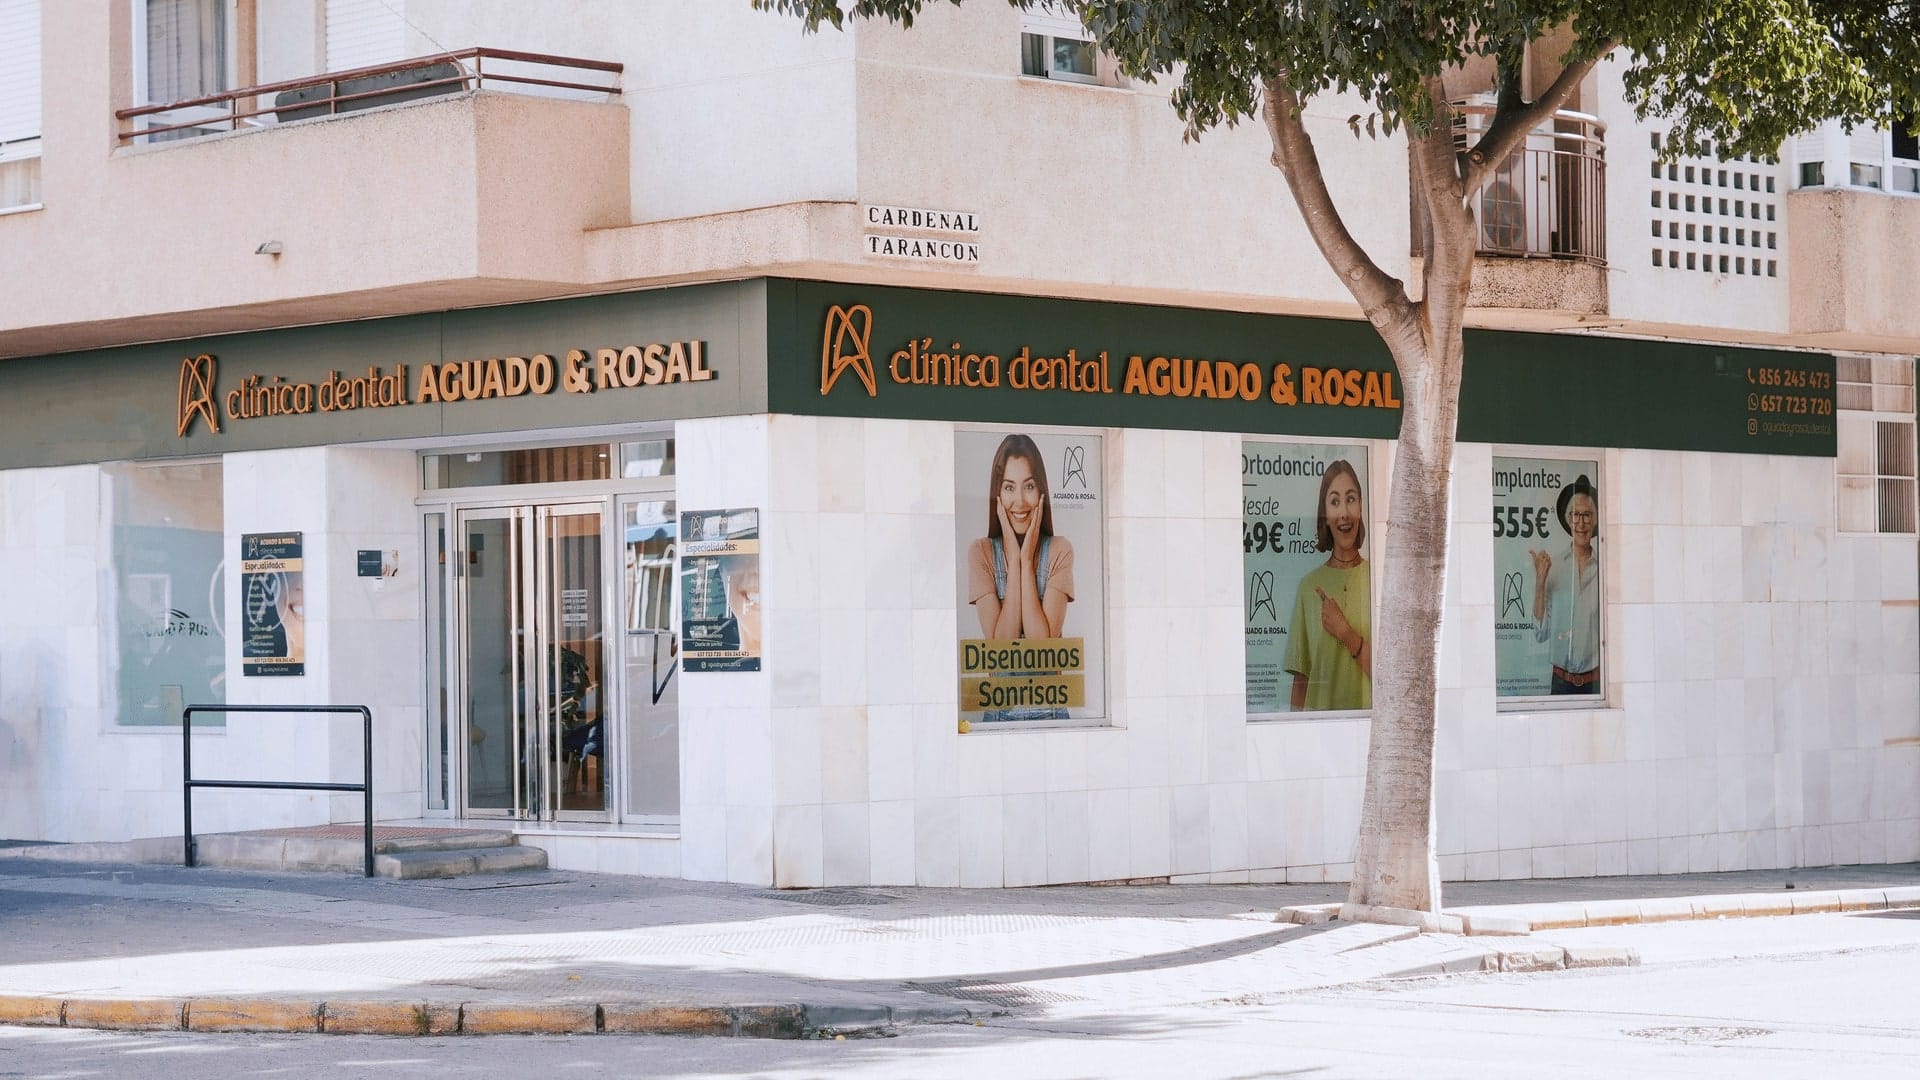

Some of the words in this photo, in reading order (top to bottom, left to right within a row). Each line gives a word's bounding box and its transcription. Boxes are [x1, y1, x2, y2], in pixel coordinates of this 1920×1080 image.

[869, 207, 978, 231] CARDENAL
[869, 237, 978, 261] TARANCON
[226, 374, 312, 420] clínica
[318, 362, 408, 412] dental
[416, 354, 554, 404] AGUADO
[563, 349, 592, 394] &
[597, 339, 713, 389] ROSAL
[890, 337, 1000, 388] clínica
[1008, 346, 1113, 393] dental
[1123, 355, 1262, 401] AGUADO
[1270, 362, 1297, 406] &
[1302, 367, 1400, 409] ROSAL
[1759, 367, 1781, 386] 856
[1784, 369, 1806, 388] 245
[1809, 371, 1830, 389] 473
[1761, 394, 1783, 412] 657
[1785, 396, 1807, 414] 723
[1810, 397, 1832, 415] 720
[1288, 517, 1302, 536] al
[1269, 627, 1287, 635] ROSAL
[965, 641, 1080, 670] Diseñamos
[978, 679, 1068, 707] Sonrisas
